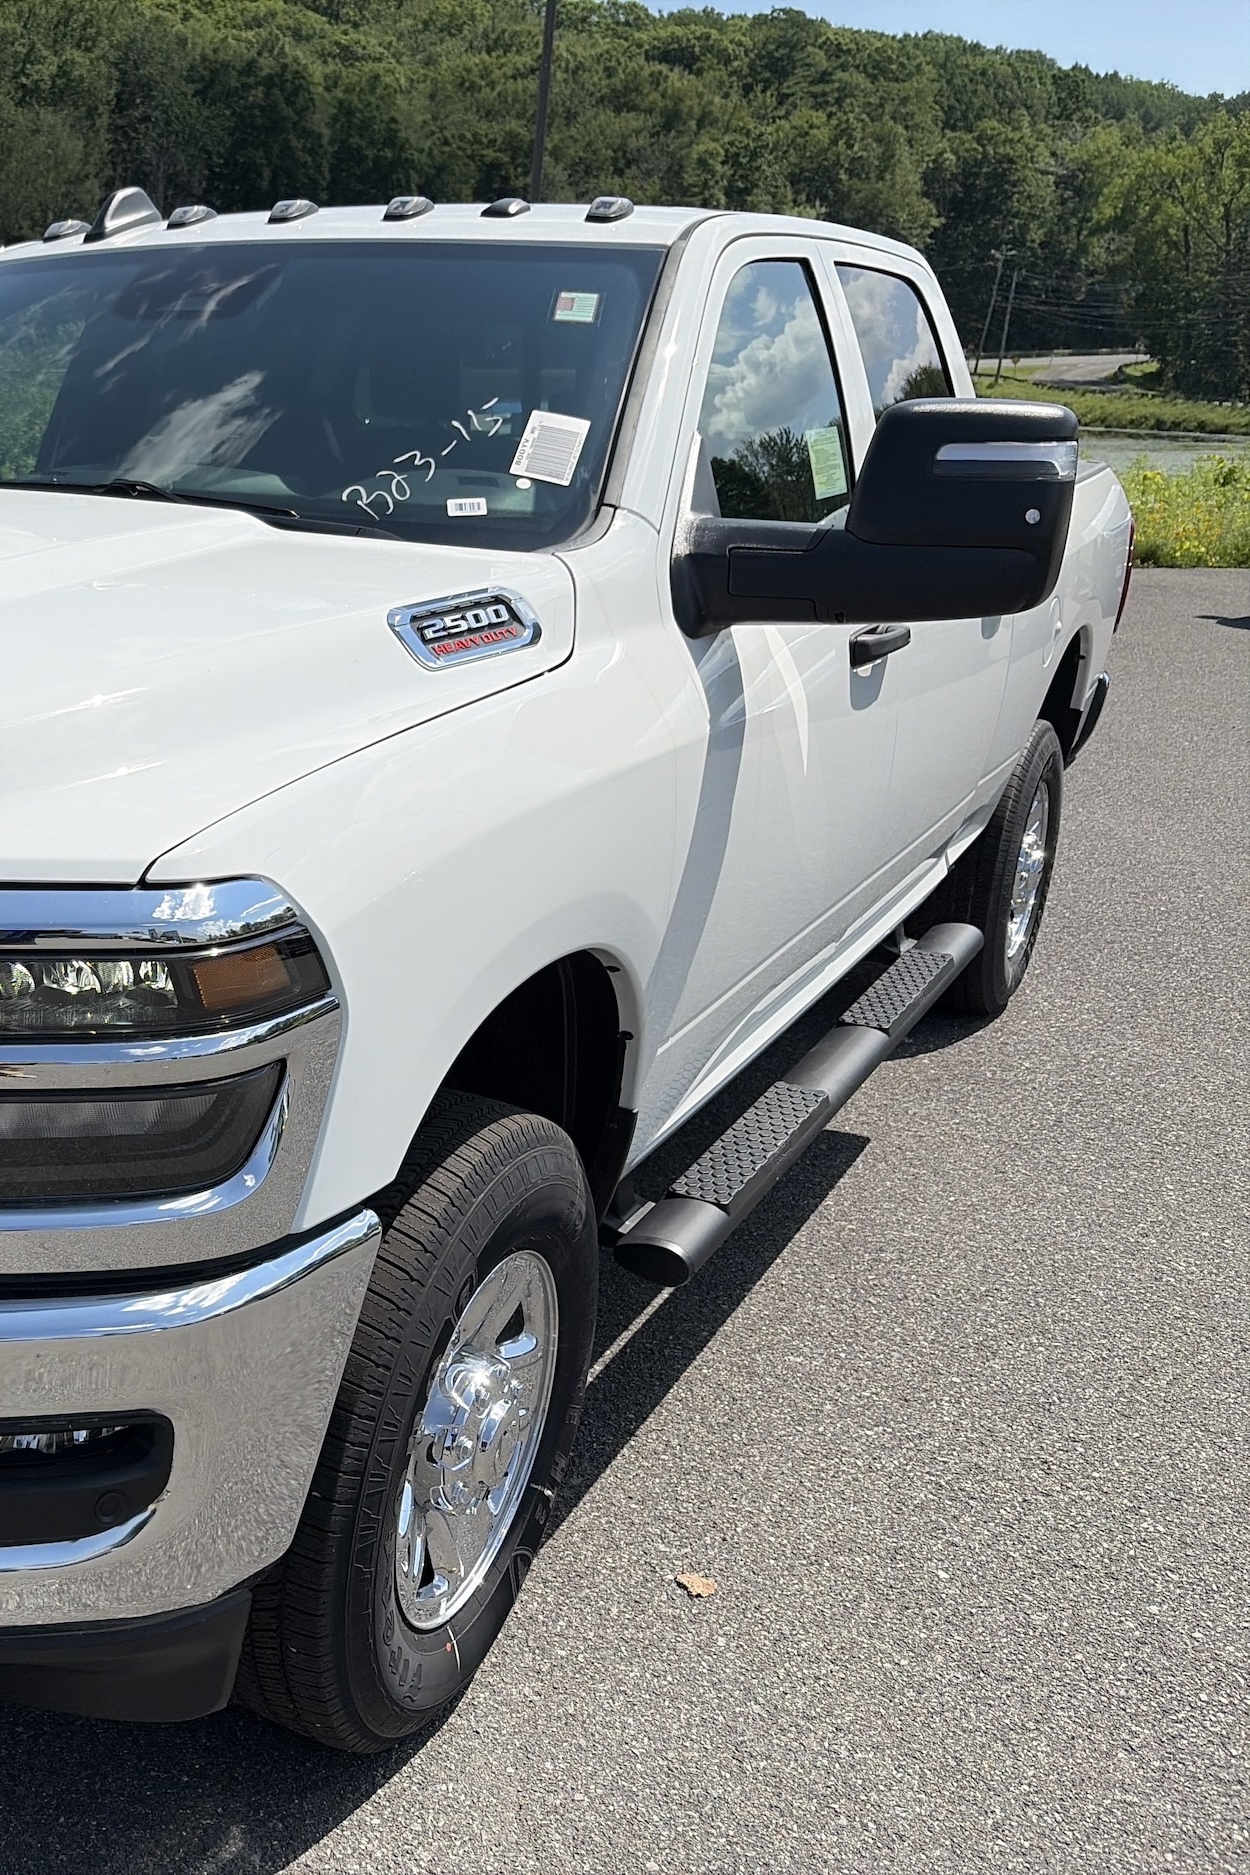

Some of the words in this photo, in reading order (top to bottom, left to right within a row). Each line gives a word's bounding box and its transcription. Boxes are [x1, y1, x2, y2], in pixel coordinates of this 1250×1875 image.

[421, 604, 510, 640] 2500
[431, 635, 480, 656] HEAVY
[481, 627, 518, 645] DUTY
